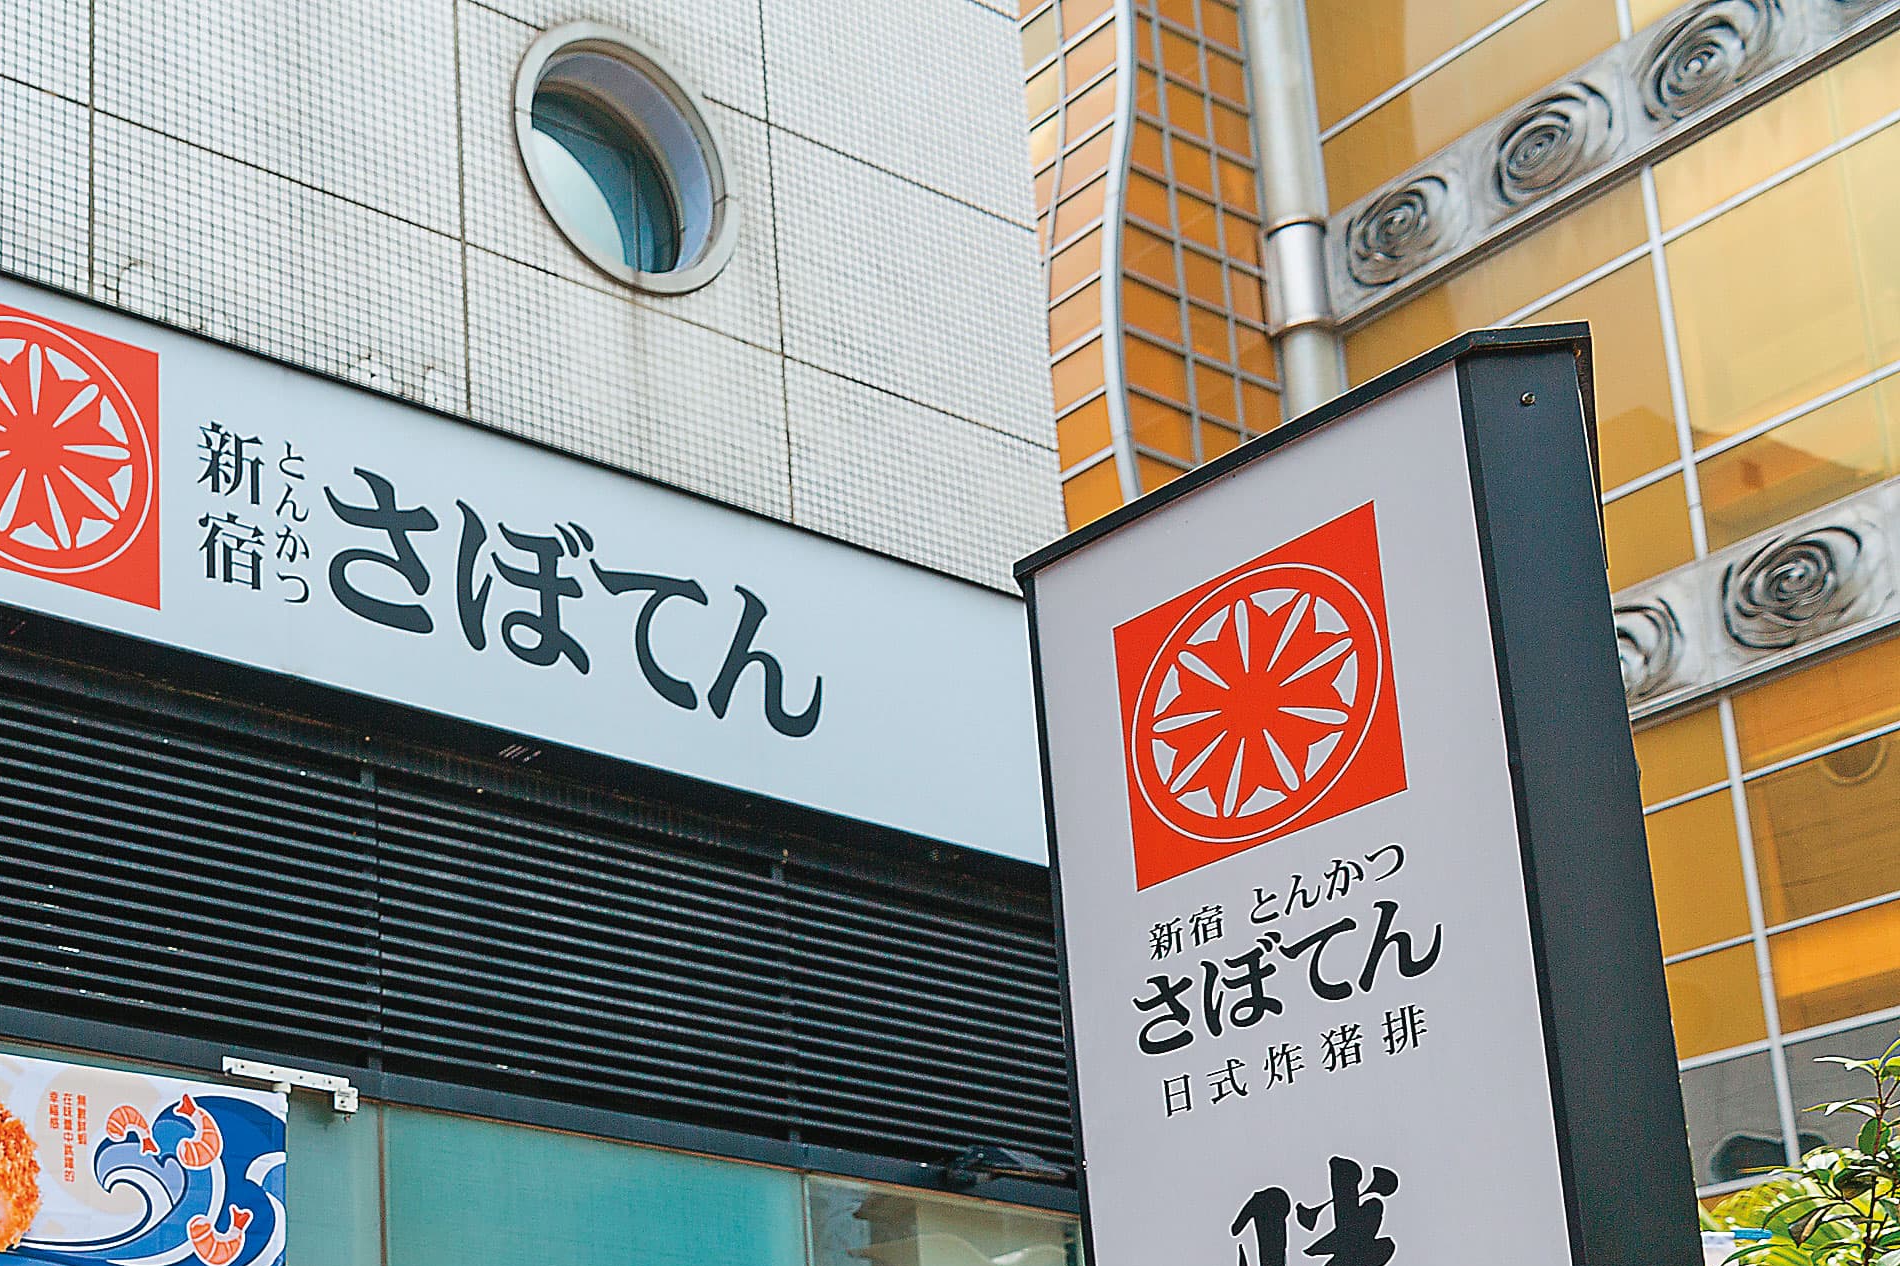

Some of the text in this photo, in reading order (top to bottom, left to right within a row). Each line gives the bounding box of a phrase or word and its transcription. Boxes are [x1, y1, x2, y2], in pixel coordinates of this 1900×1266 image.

[198, 422, 263, 591] 新宿
[275, 442, 309, 603] とんかつ
[323, 467, 822, 738] さぼてん
[1132, 901, 1441, 1054] さぼてん
[1149, 845, 1404, 960] 新宿 とんかつ
